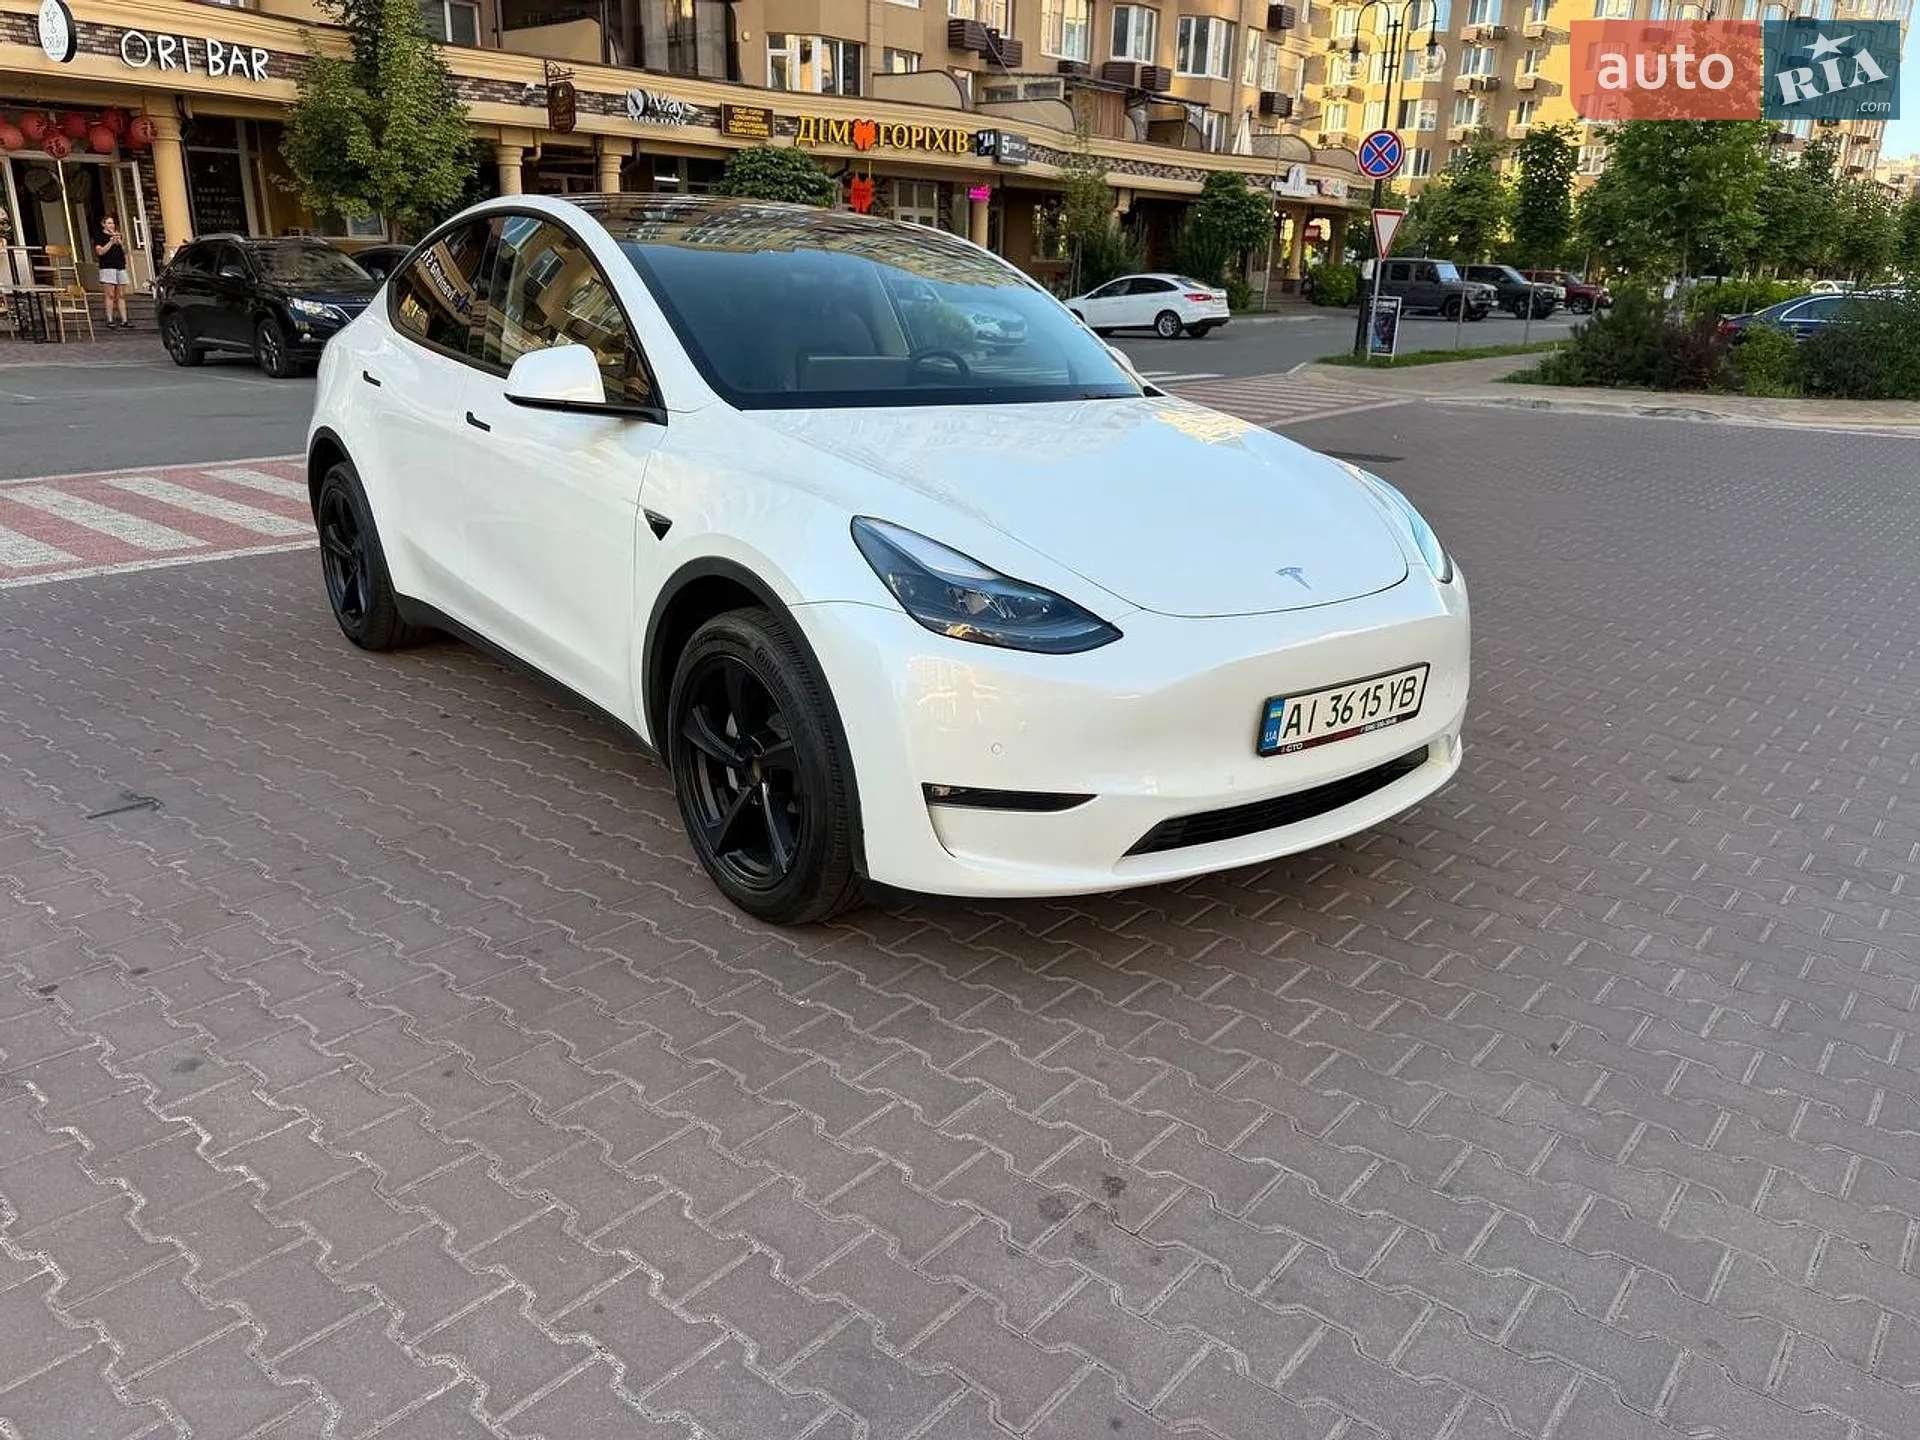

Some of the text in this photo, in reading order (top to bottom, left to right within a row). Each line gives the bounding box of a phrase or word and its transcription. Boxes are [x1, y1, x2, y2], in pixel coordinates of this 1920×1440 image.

[121, 30, 269, 81] ORI BAR
[794, 115, 849, 147] ДІМ
[879, 123, 969, 153] ГОРІХІВ
[1326, 683, 1383, 728] 3615
[1389, 675, 1417, 712] YB
[1264, 730, 1278, 742] UA
